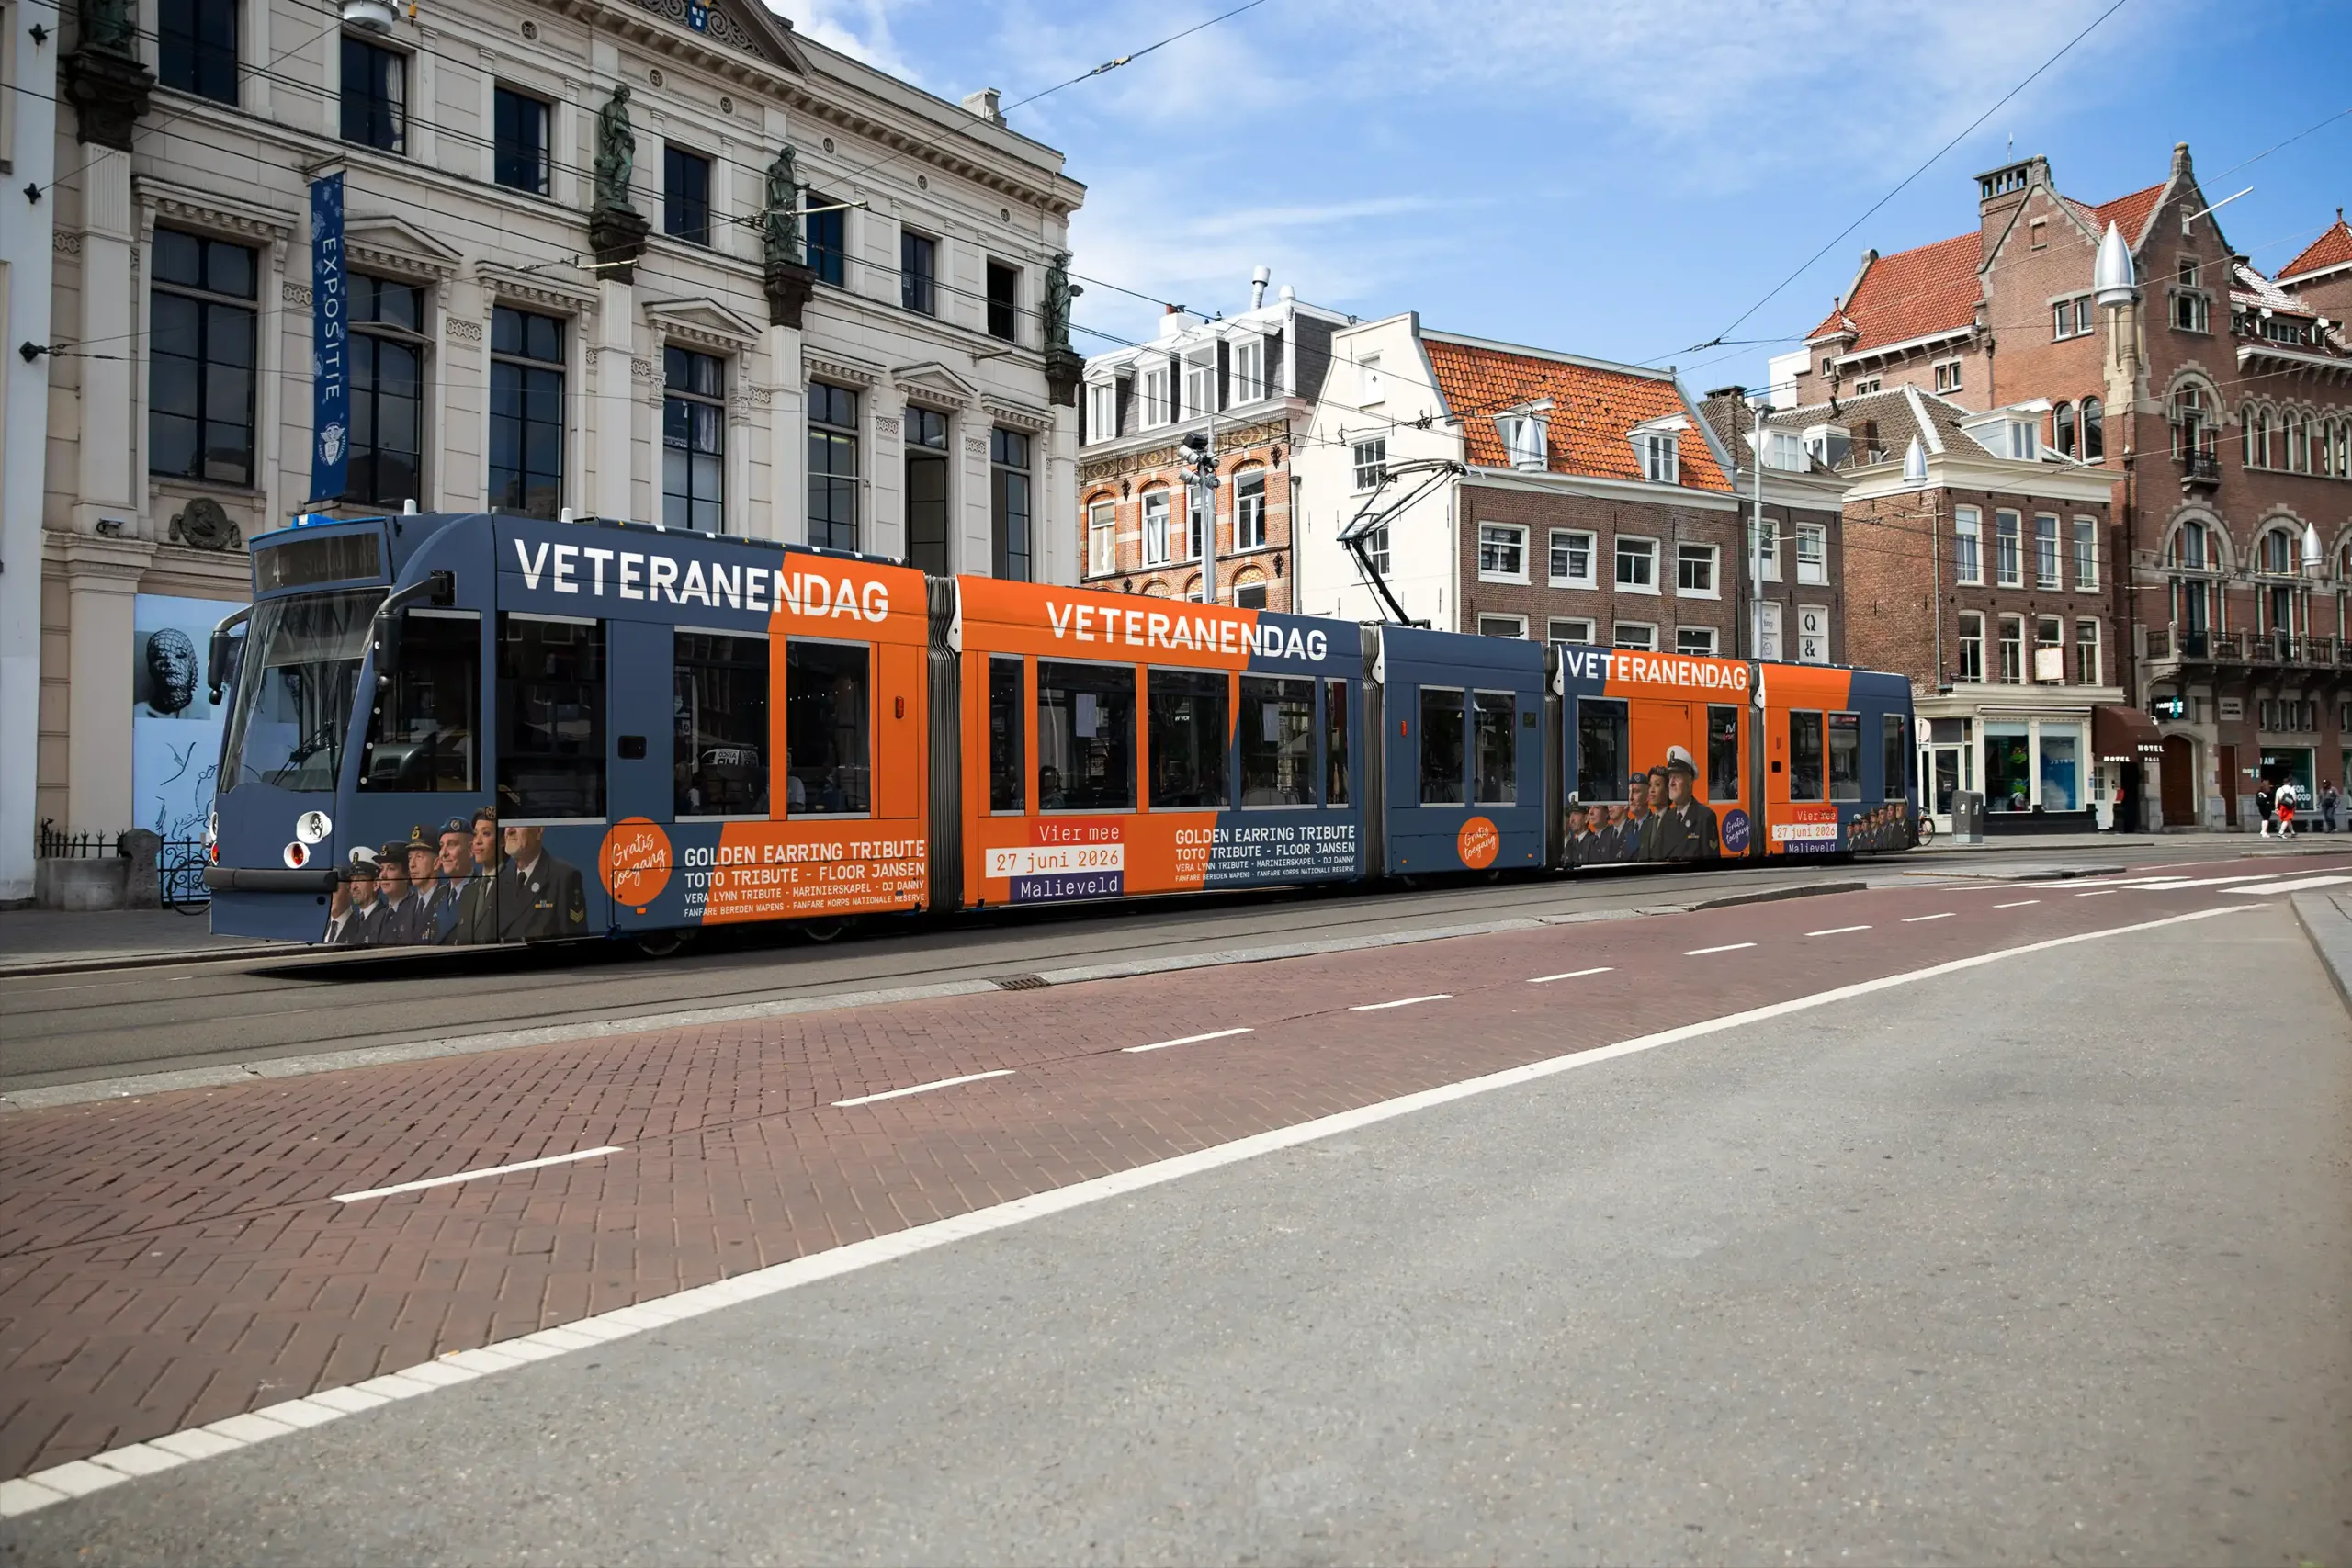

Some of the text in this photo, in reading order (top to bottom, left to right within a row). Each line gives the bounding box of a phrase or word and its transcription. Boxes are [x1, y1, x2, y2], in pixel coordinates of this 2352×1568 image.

[322, 237, 340, 400] EXPOSITIE
[514, 538, 889, 623] VETERANENDAG
[1046, 601, 1328, 661] VETERANENDAG
[1566, 650, 1747, 691] VETERANENDAG
[2137, 744, 2165, 752] HOTEL
[2263, 757, 2275, 765] AM
[1726, 817, 1745, 834] Gratis
[1797, 810, 1817, 821] Vier
[1039, 825, 1119, 842] Vier mee
[1175, 825, 1355, 844] GOLDEN EARRING TRIBUTE
[1464, 826, 1489, 846] Gratis
[1777, 827, 1836, 839] 27 juni 2026
[612, 833, 654, 866] Gratis
[684, 840, 925, 867] GOLDEN EARRING TRIBUTE
[1175, 848, 1206, 861] TOTO
[1211, 845, 1261, 859] TRIBUTE
[1276, 843, 1311, 856] FLOOR
[1315, 841, 1355, 854] JANSEN
[1464, 835, 1496, 860] toegang
[1789, 842, 1836, 853] Malieveld
[610, 848, 667, 889] toegang
[997, 850, 1118, 874] 27 juni 2026
[1175, 863, 1194, 873] VERA
[1197, 862, 1216, 871] LYNN
[1218, 860, 1249, 870] TRIBUTE
[1257, 857, 1316, 867] MARINIERSKAPEL
[1323, 856, 1332, 864] DJ
[1334, 855, 1354, 863] DANNY
[684, 871, 725, 888] TOTO
[731, 867, 798, 886] TRIBUTE
[820, 864, 865, 882] FLOOR
[871, 862, 925, 879] JANSEN
[1175, 874, 1201, 883] FANFARE
[1203, 873, 1227, 881] BEREDEN
[1229, 871, 1250, 879] WAPENS
[1257, 869, 1281, 877] FANFARE
[1301, 866, 1330, 874] NATIONALE
[684, 892, 709, 904] VERA
[713, 890, 737, 903] LYNN
[741, 888, 781, 901] TRIBUTE
[793, 885, 871, 897] MARINIERSKAPEL
[882, 882, 893, 892] DJ
[897, 880, 924, 891] DANNY
[1021, 875, 1118, 898] Malieveld
[684, 906, 718, 918] FANFARE
[720, 904, 753, 915] BEREDEN
[756, 903, 784, 913] WAPENS
[793, 900, 825, 910] FANFARE
[827, 898, 850, 908] KORPS
[852, 895, 892, 906] NATIONALE
[895, 893, 925, 903] RESERVE
